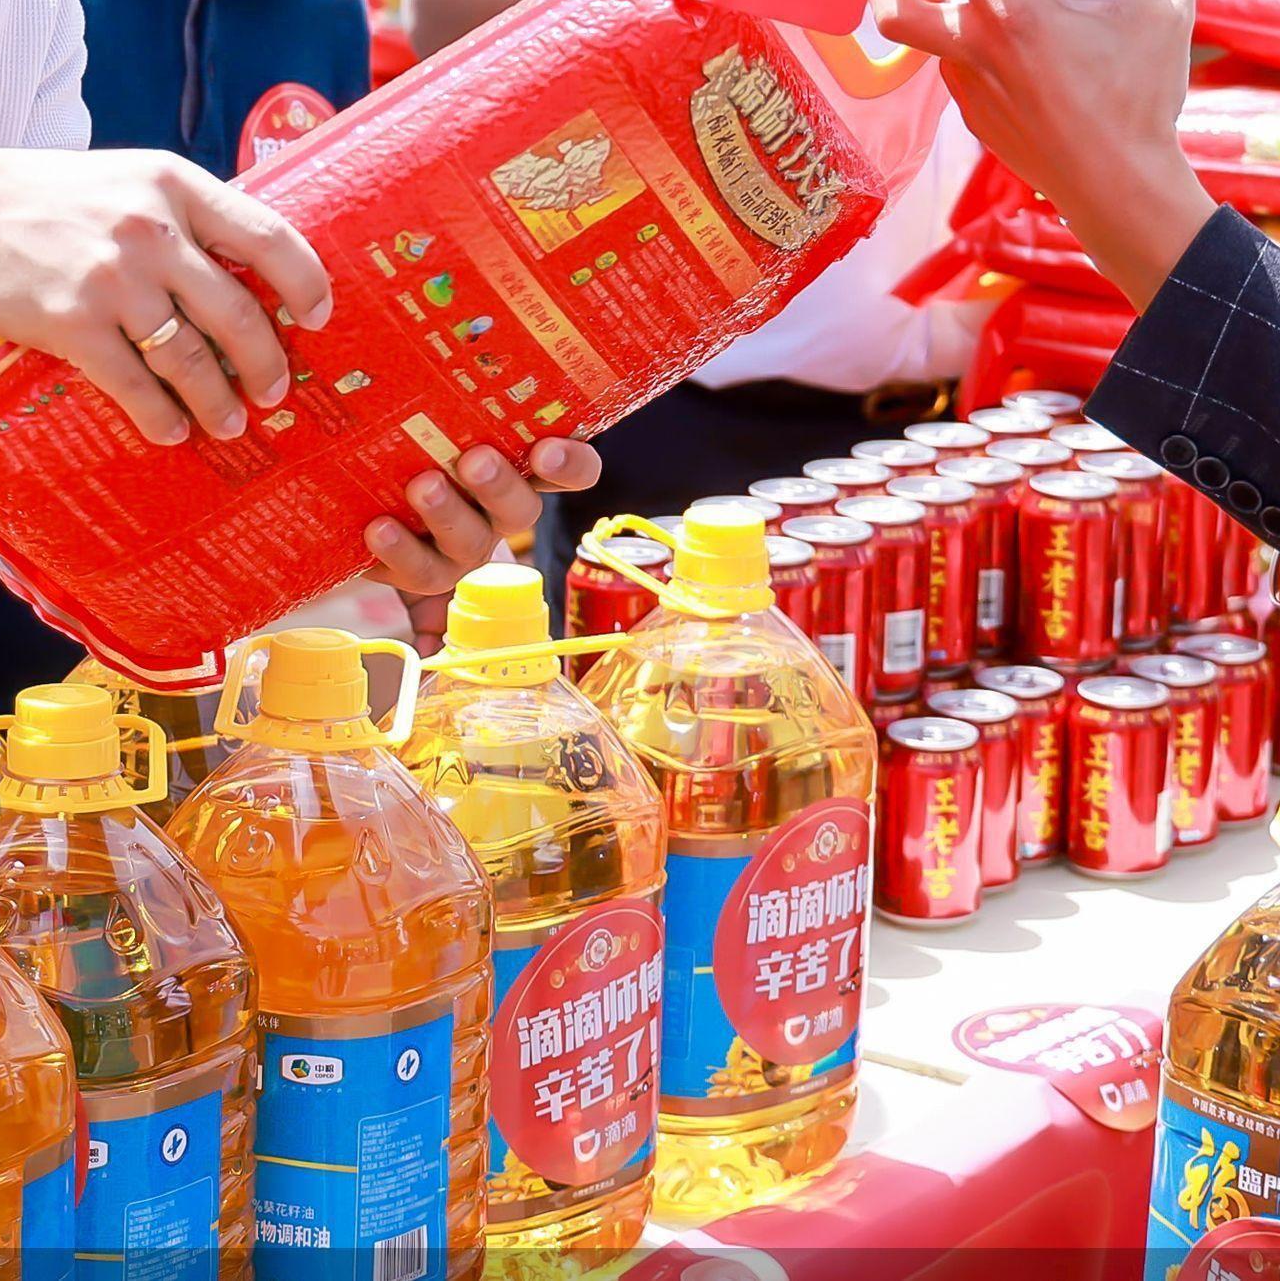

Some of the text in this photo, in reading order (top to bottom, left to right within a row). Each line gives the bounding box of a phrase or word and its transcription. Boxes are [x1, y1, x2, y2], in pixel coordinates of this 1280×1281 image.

[1040, 524, 1076, 640] 王老吉
[923, 777, 960, 899] 王老吉
[1079, 734, 1114, 851] 王老吉
[517, 948, 662, 1069] 滴滴师傅
[534, 1017, 658, 1122] 辛苦了!
[604, 1110, 637, 1148] 滴滴
